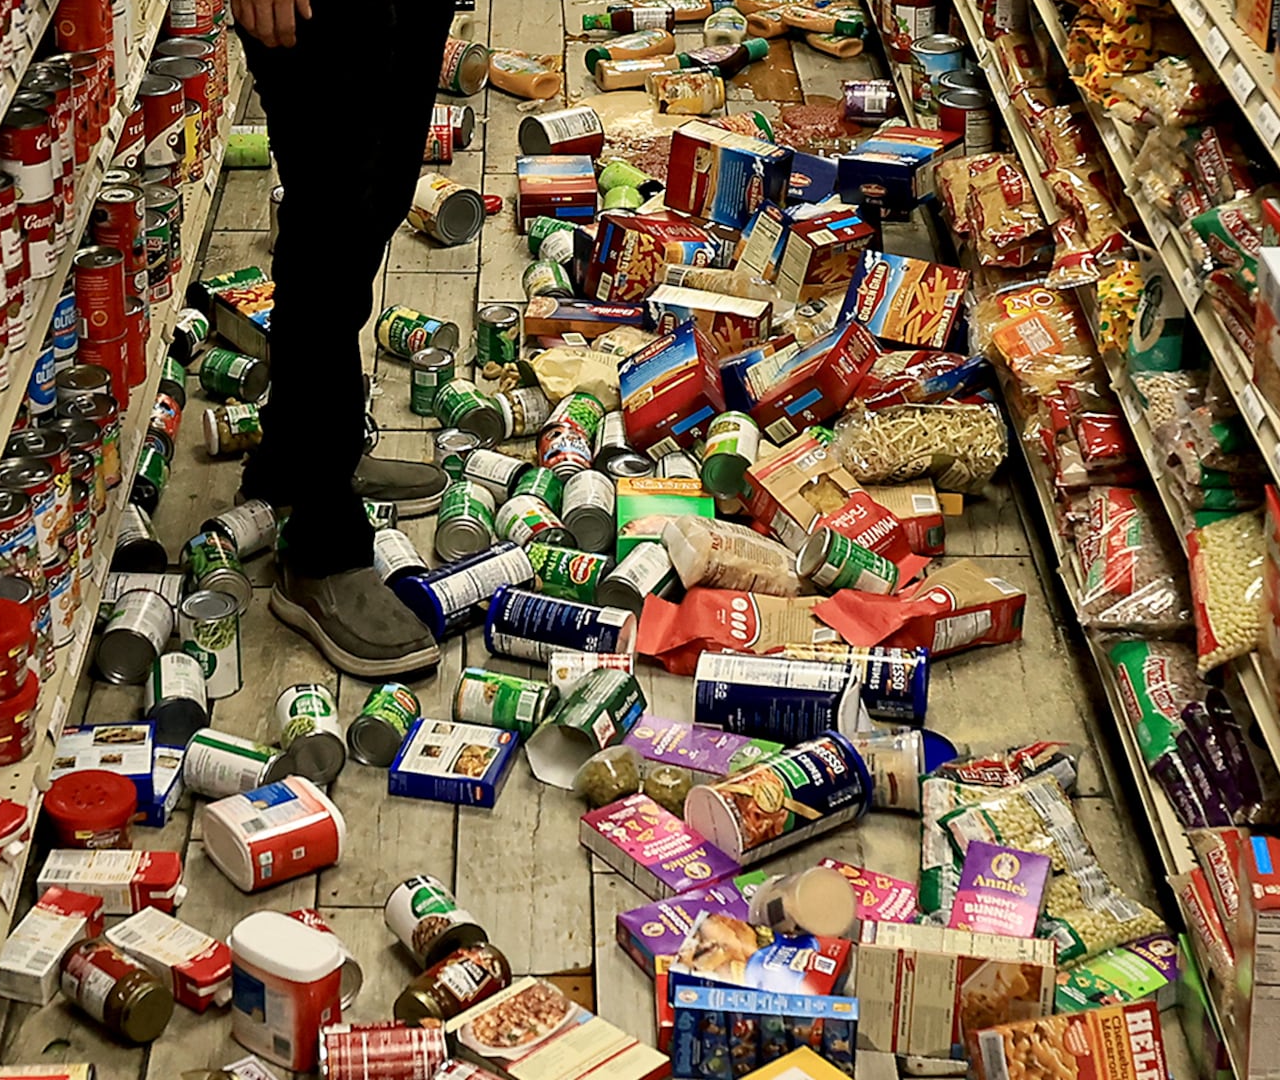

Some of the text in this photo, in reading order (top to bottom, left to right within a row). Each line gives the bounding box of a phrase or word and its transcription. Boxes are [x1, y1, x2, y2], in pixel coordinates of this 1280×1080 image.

[858, 263, 887, 322] GOLDEN GRAIN
[660, 846, 708, 872] Annie's
[972, 874, 1029, 897] Annie's
[964, 902, 1024, 922] BUNNIES
[974, 893, 1019, 911] YUMMY
